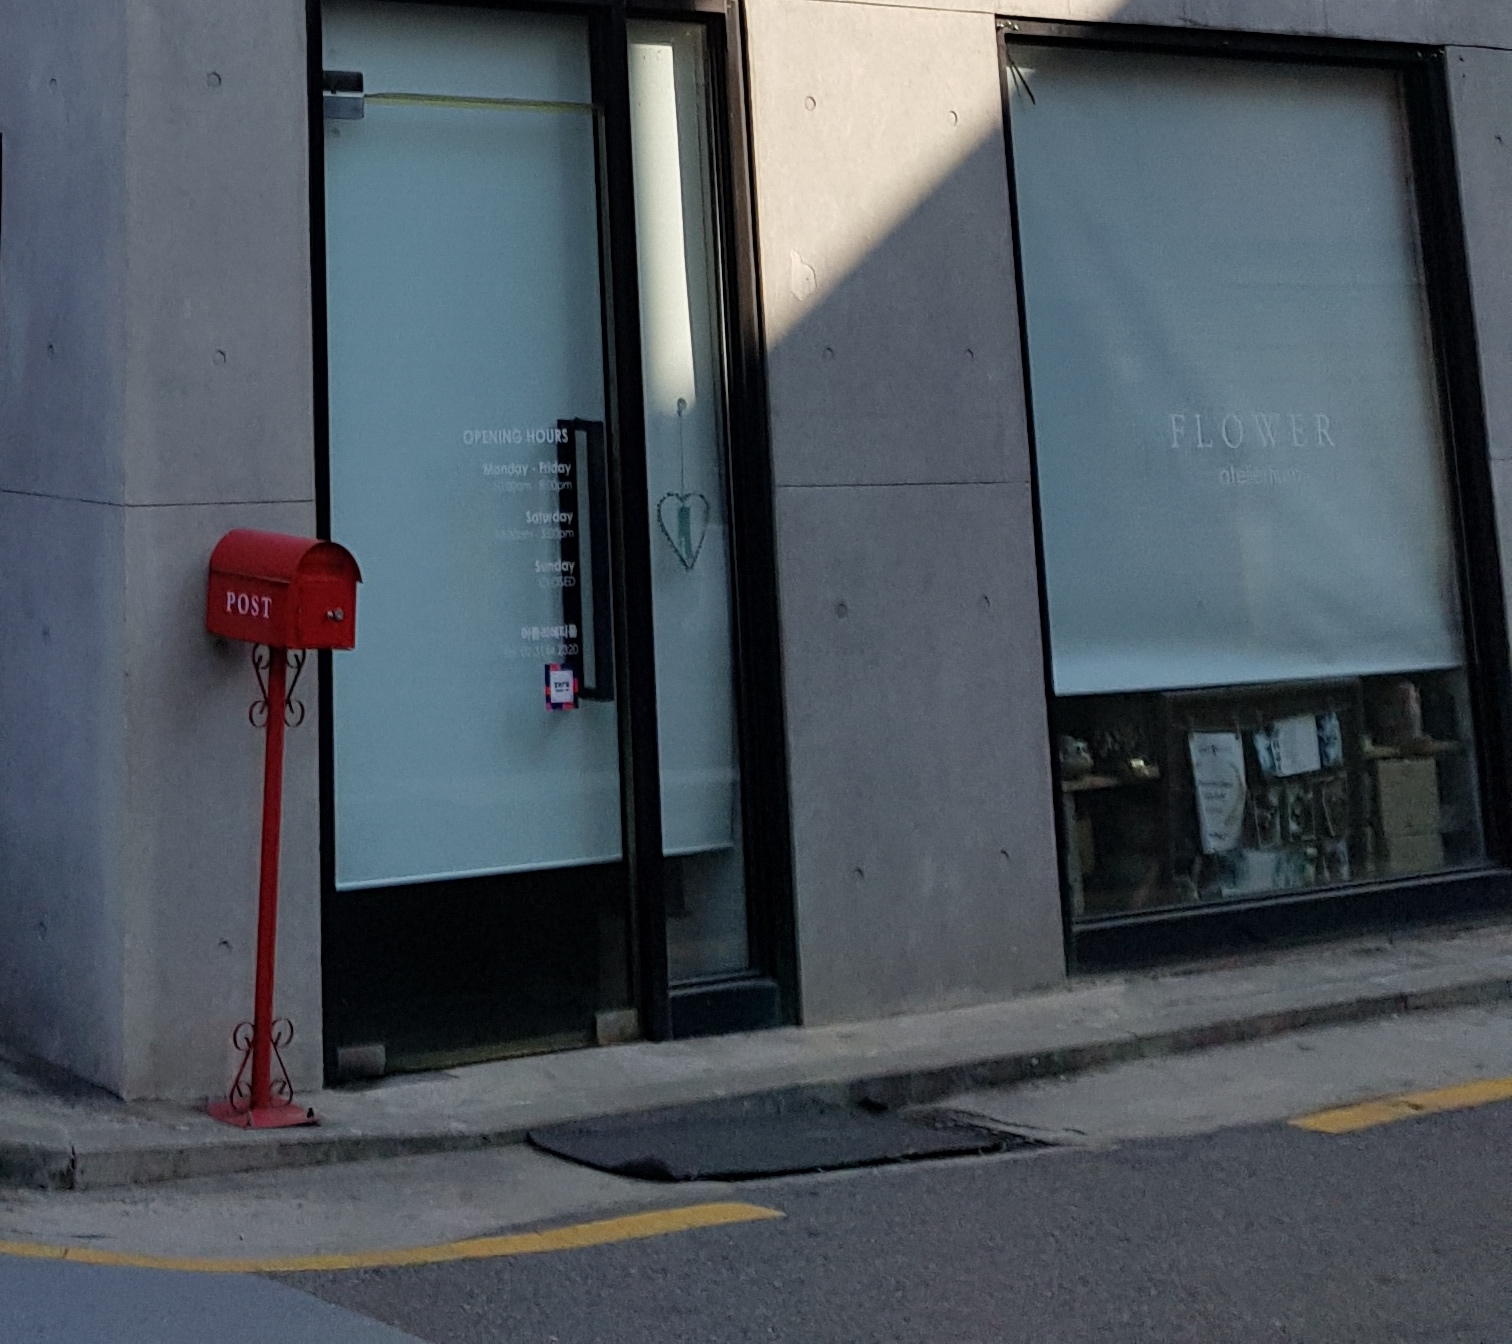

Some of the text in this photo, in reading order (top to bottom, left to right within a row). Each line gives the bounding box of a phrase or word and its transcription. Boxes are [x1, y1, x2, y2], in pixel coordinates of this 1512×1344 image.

[463, 427, 569, 445] OPENING HOURS
[1170, 413, 1336, 449] FLOWER
[483, 462, 529, 477] Monday
[538, 461, 572, 476] Friday
[526, 510, 574, 525] Saturday
[535, 560, 576, 575] Sunday
[226, 591, 273, 619] POST
